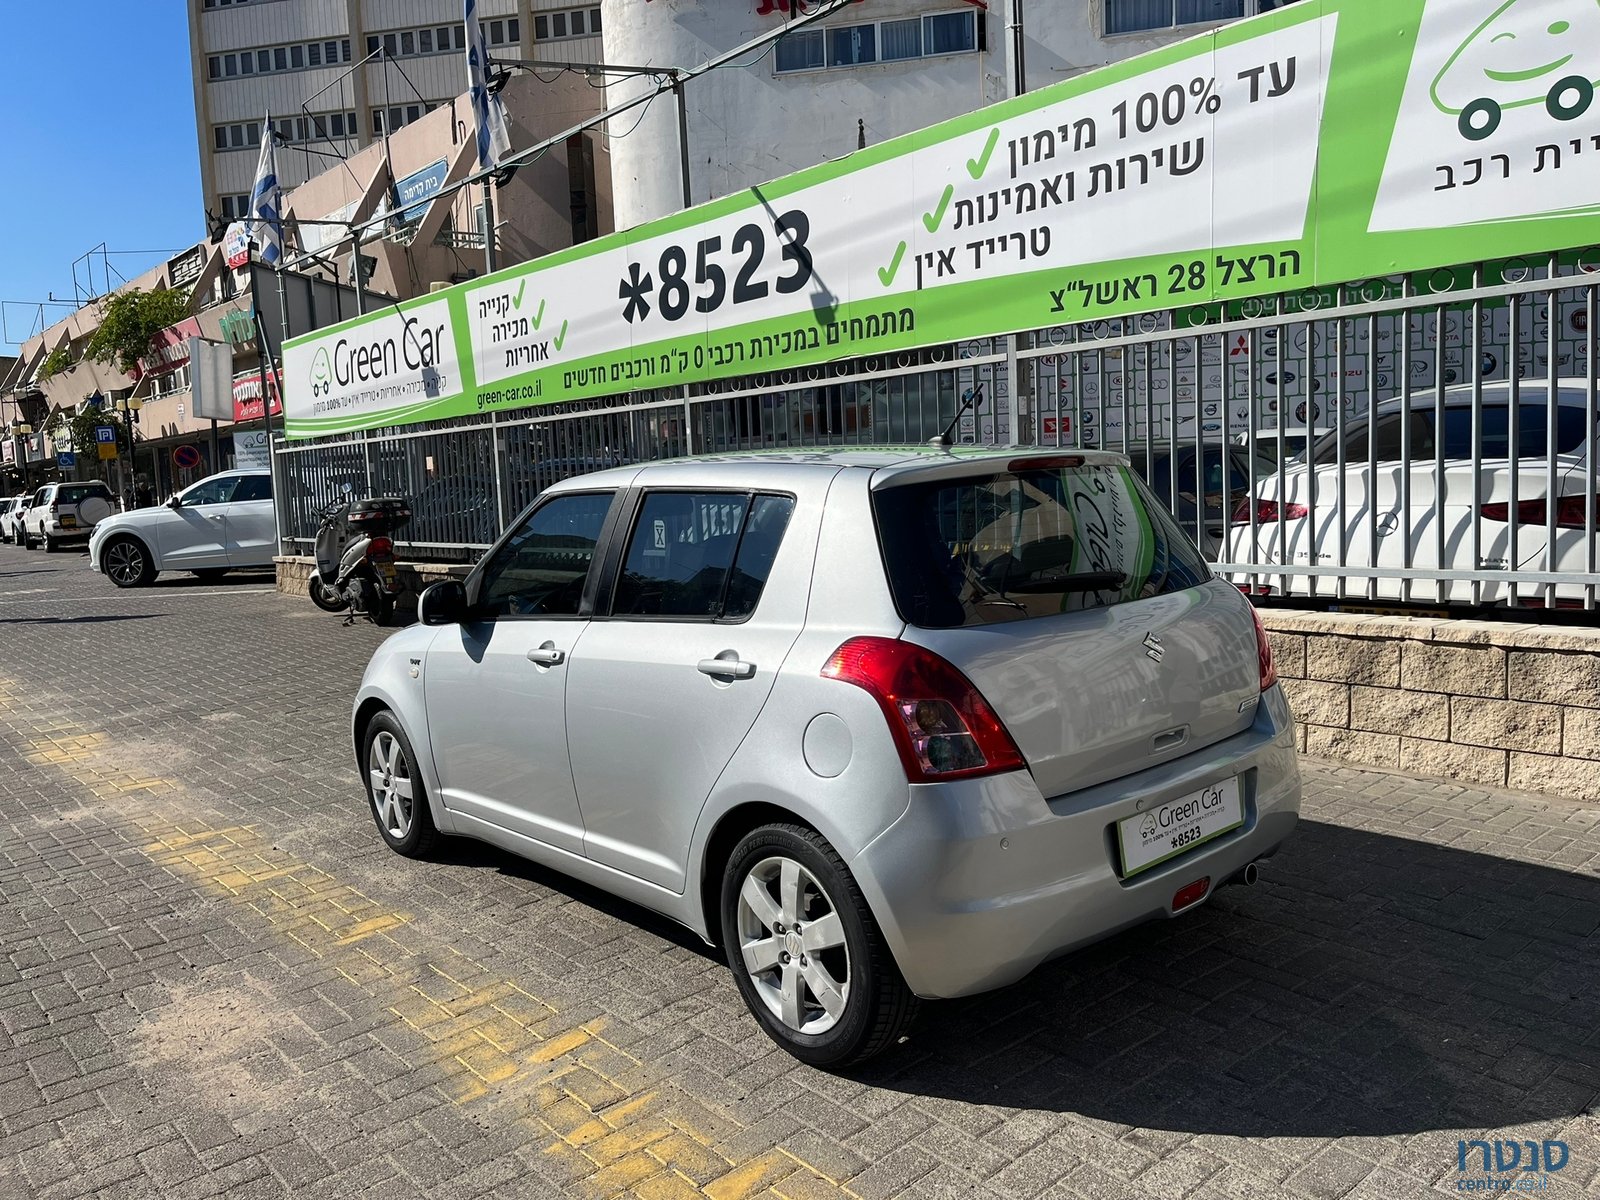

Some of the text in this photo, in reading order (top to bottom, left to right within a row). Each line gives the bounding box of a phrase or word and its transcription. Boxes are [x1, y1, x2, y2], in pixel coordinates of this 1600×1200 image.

[1008, 56, 1297, 179] עד 100% מימון
[953, 137, 1205, 231] שירות ואמינות
[1434, 153, 1510, 191] רכב
[914, 225, 1051, 290] טרייד אין
[1215, 249, 1301, 283] הרצל
[1168, 260, 1206, 294] 28
[479, 294, 510, 319] קנייה
[493, 318, 527, 343] מכירה
[750, 326, 819, 359] במכירת
[826, 308, 915, 345] מתמחים
[334, 317, 444, 386] Green Car
[505, 341, 549, 368] אחריות
[693, 345, 704, 368] 0
[708, 341, 744, 366] רכבי
[564, 362, 607, 389] חדשים
[611, 355, 655, 382] ורכבים
[477, 379, 542, 409] green-car.co.il
[1158, 799, 1200, 828] Green
[1201, 788, 1224, 809] Car
